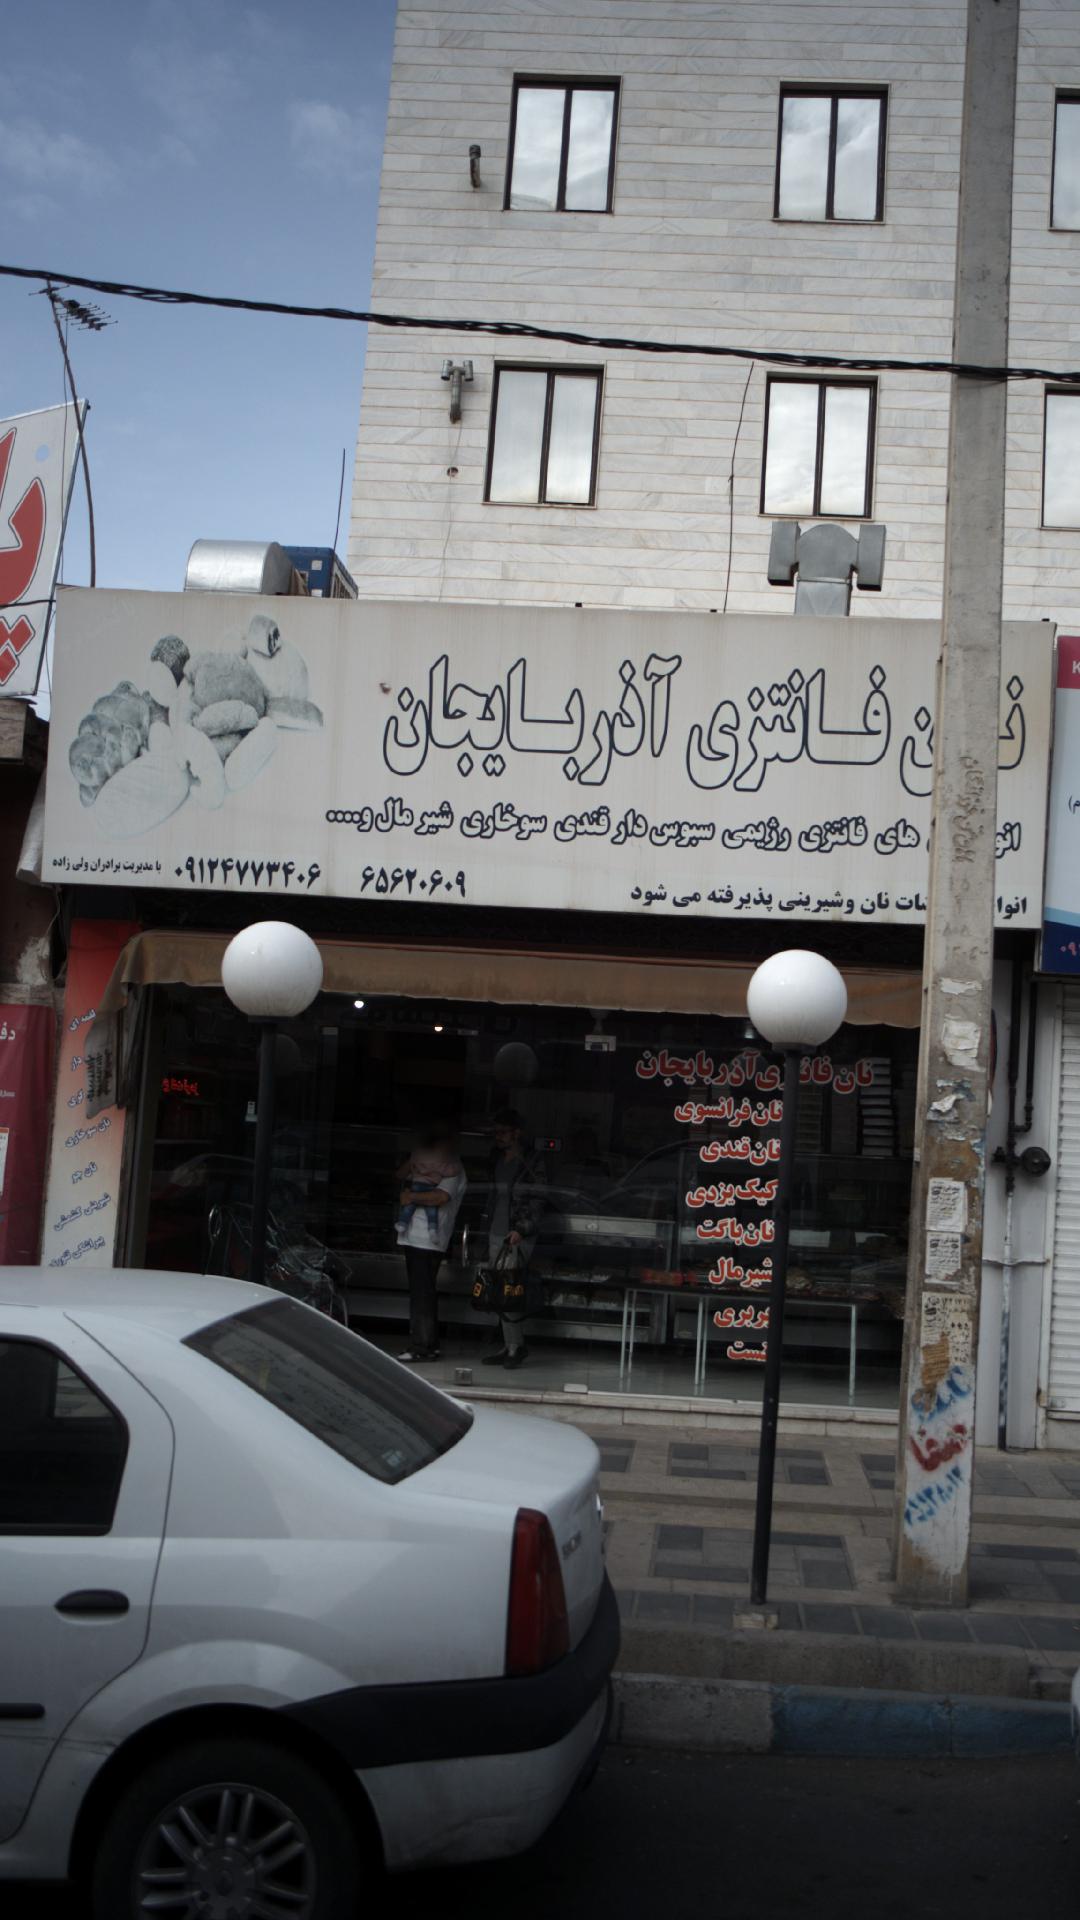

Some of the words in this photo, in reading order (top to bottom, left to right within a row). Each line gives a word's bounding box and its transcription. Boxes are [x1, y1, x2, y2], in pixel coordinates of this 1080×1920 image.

[383, 653, 682, 787] آذربایجان
[687, 664, 891, 792] فانتزی
[460, 803, 547, 841] سوخاری
[554, 806, 611, 843] قندی
[611, 808, 648, 845] دار
[649, 821, 715, 847] سبوس
[722, 816, 791, 851] رژیمی
[798, 816, 868, 853] فانتزی
[874, 818, 920, 856] های
[90, 857, 121, 873] برادران
[122, 860, 153, 874] مدیریت
[174, 856, 321, 889] ۰۹۱۲۴۷۷۳۴۰۶
[360, 865, 466, 899] ۶۵۶۲۰۶۰۹
[630, 884, 667, 906] شود
[672, 891, 702, 908] می
[707, 884, 773, 912] پذیرفته
[860, 891, 890, 914] نان
[996, 896, 1027, 920] انوا
[755, 1055, 833, 1092] فانی
[833, 1058, 875, 1093] نان
[674, 1097, 752, 1127] فرانسوی
[751, 1099, 783, 1126] نان
[699, 1137, 752, 1163] قندی
[686, 1182, 736, 1208] یزدی
[735, 1177, 779, 1206] کیک
[696, 1217, 744, 1245] باگت
